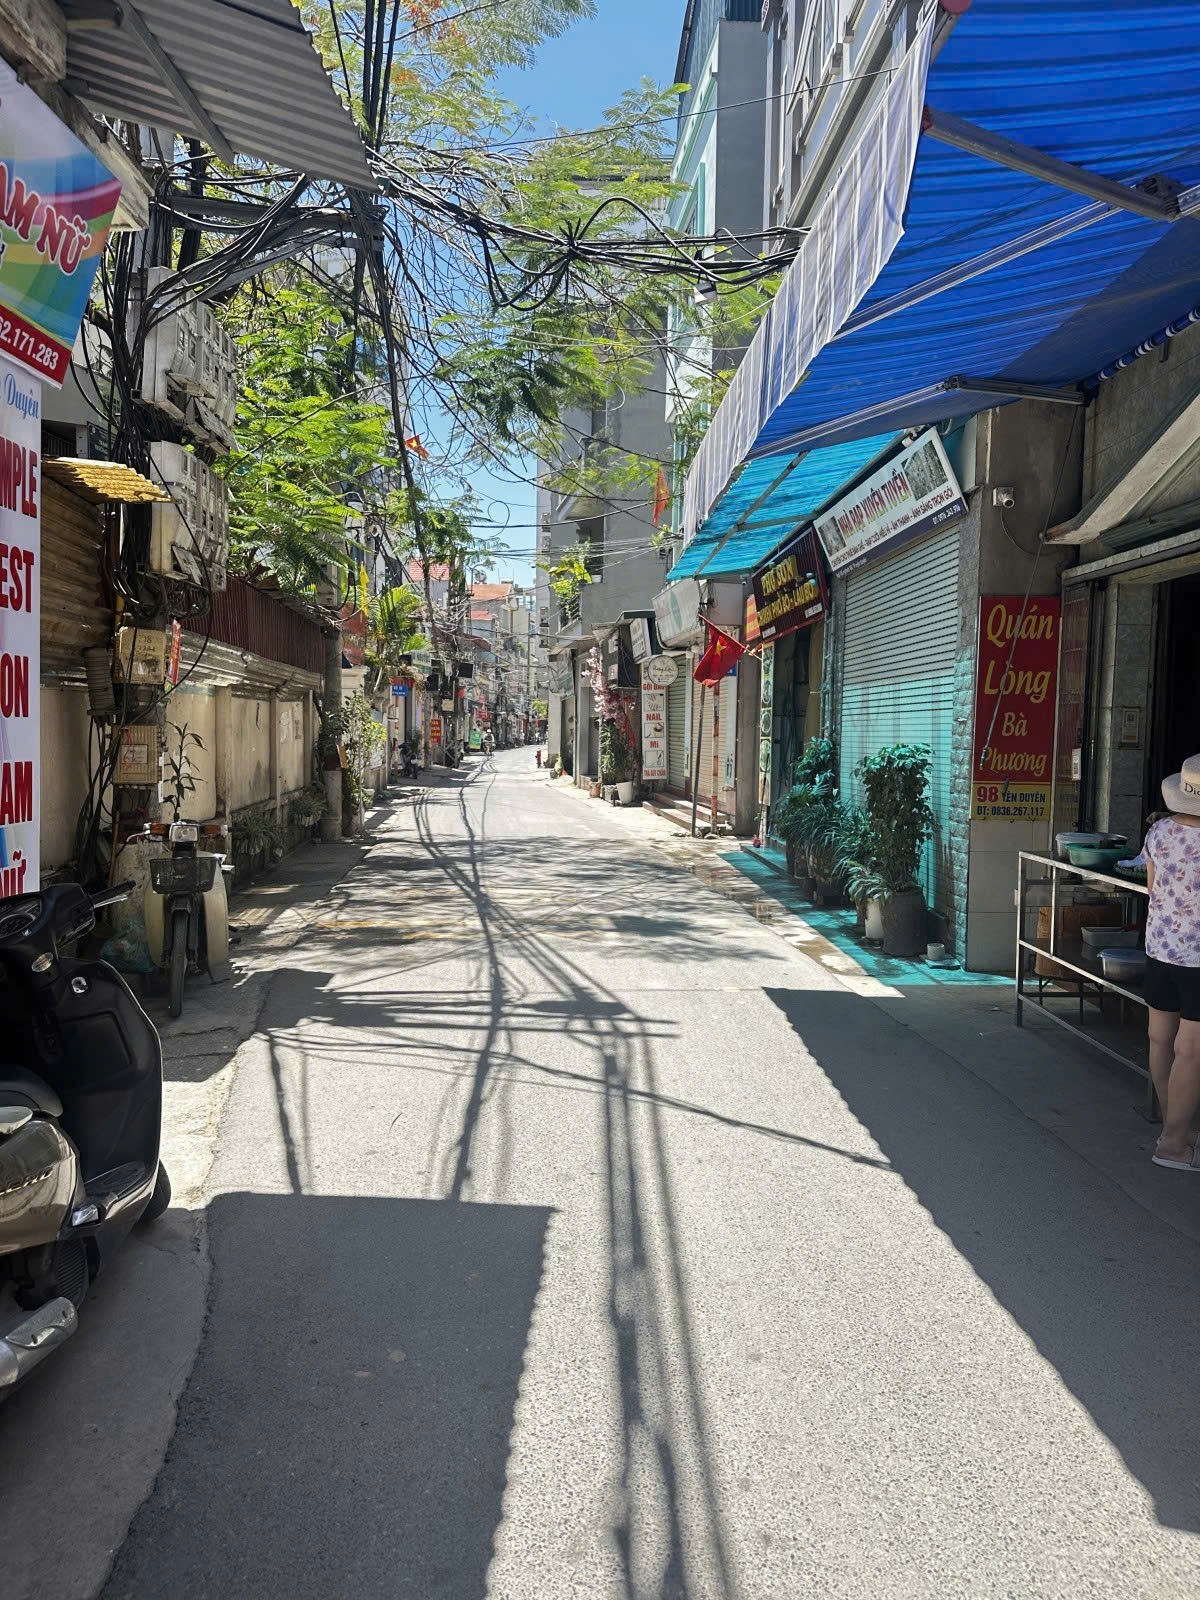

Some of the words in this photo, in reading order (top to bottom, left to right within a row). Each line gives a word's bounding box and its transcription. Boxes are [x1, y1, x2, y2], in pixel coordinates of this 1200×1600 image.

[36, 205, 91, 274] NỮ
[0, 315, 59, 370] 2.171.283
[4, 373, 39, 419] Duyên
[860, 487, 888, 524] XUYÊN
[987, 603, 1054, 648] Quán
[0, 653, 29, 718] ON
[984, 660, 1051, 703] Lòng
[646, 713, 663, 721] NAIL
[1002, 711, 1028, 737] Bà
[984, 747, 1048, 777] Phương
[0, 761, 33, 826] AM
[977, 785, 999, 803] 98
[1019, 790, 1046, 803] DUYÊN
